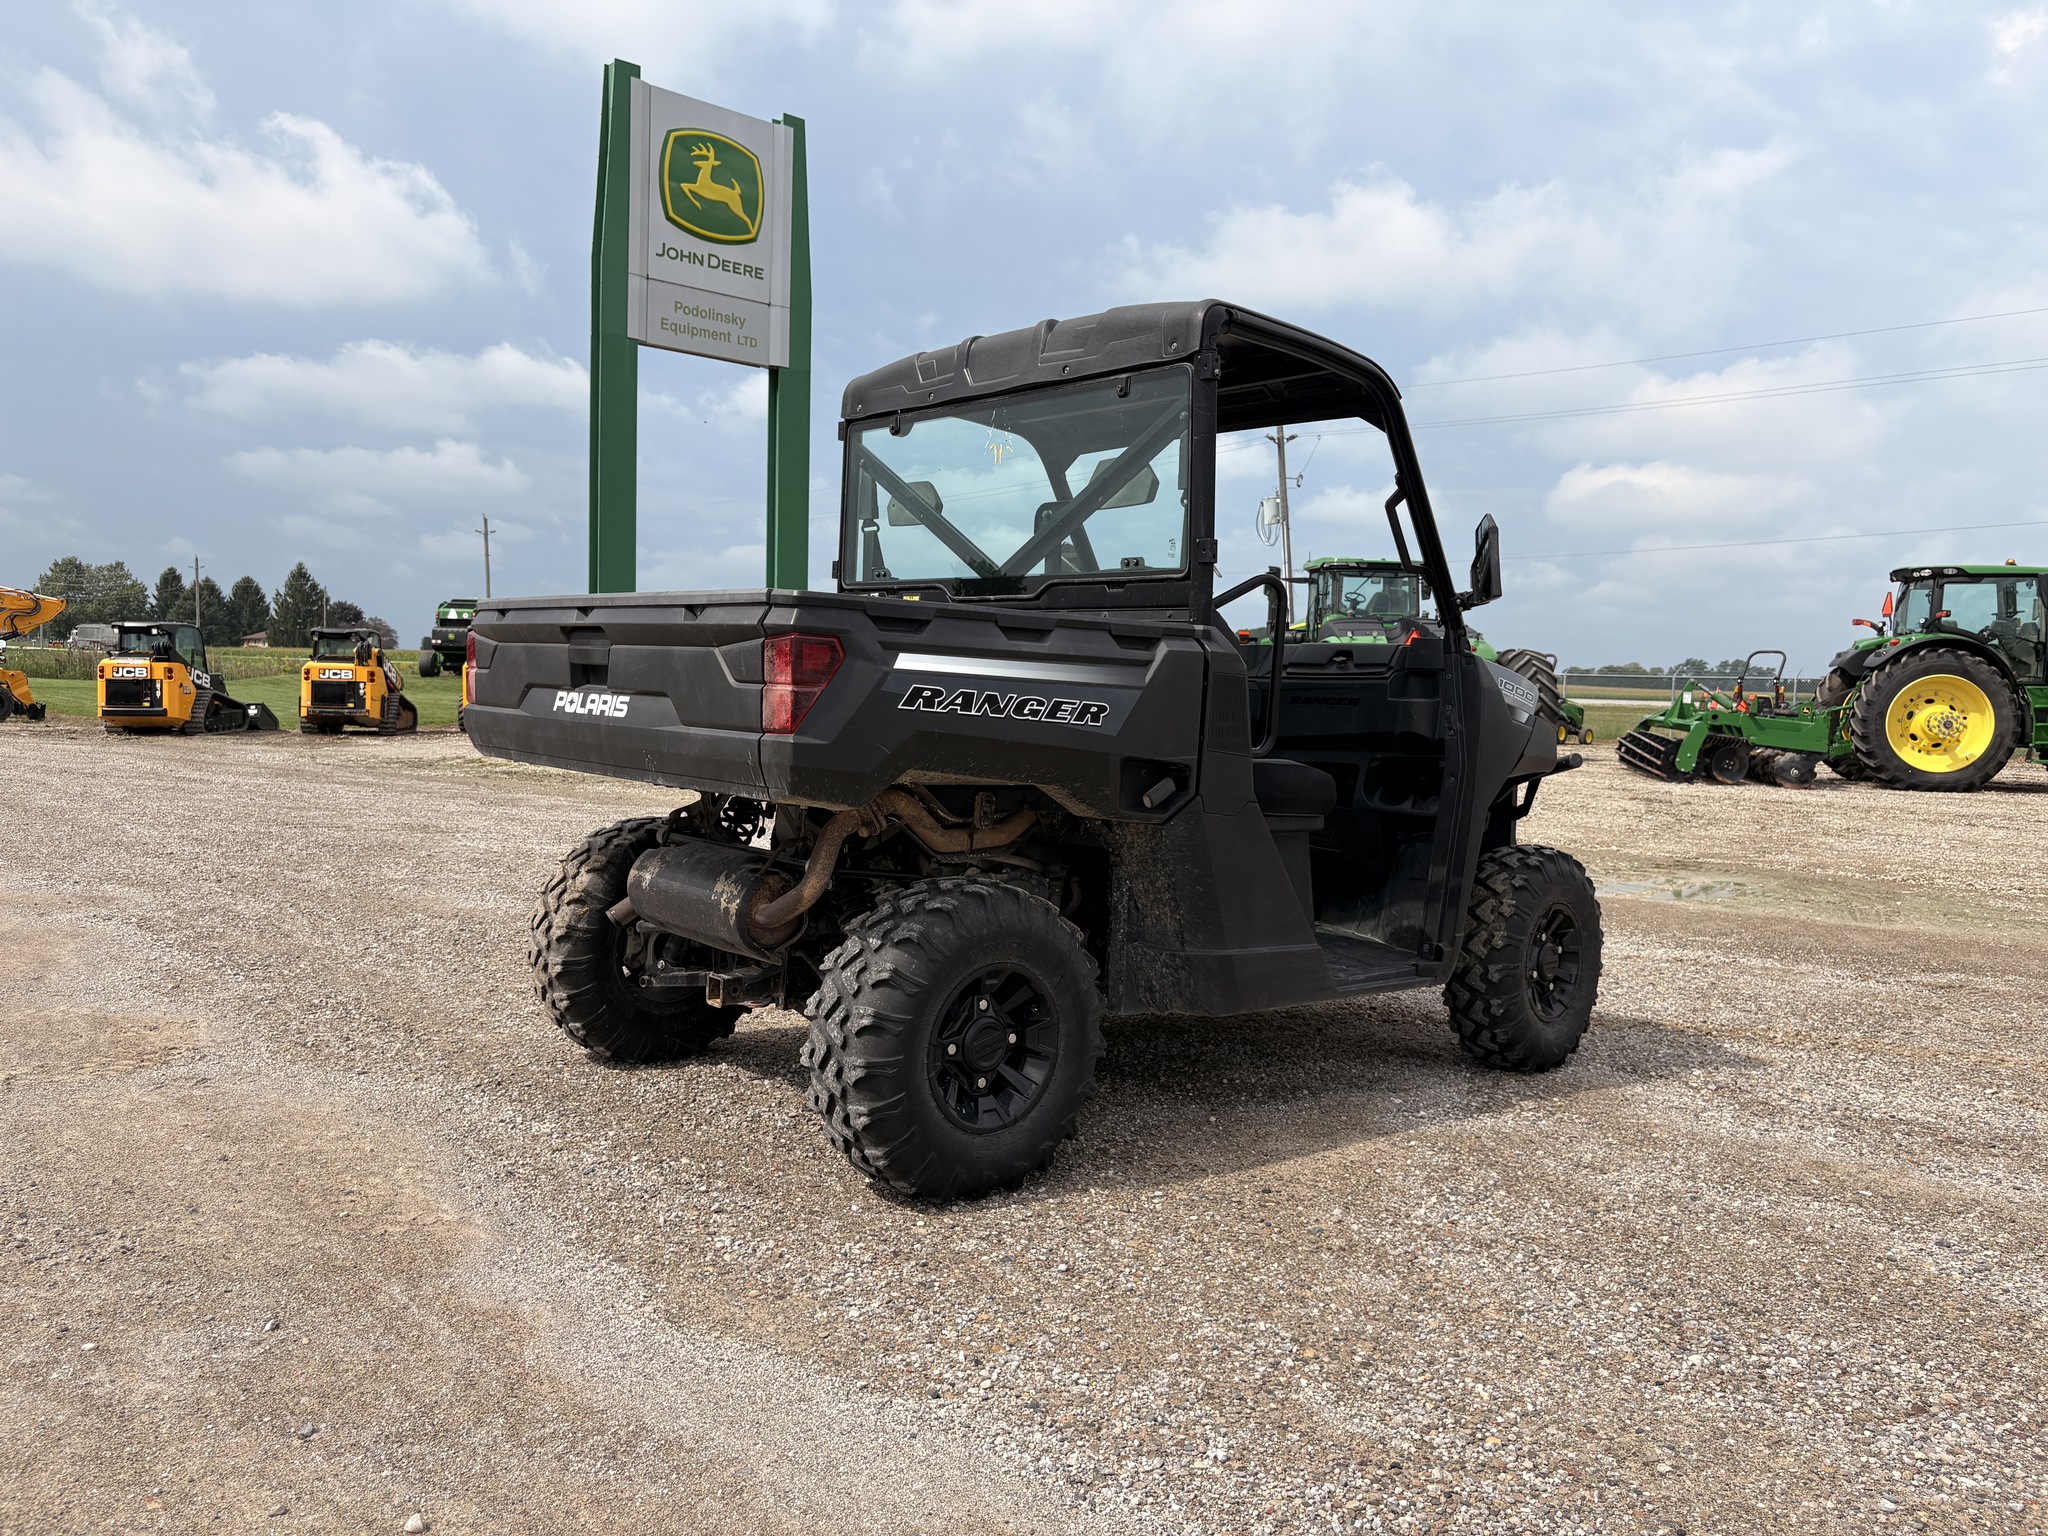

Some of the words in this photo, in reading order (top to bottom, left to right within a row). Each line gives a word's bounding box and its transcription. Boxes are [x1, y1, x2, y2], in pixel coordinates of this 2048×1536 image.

[656, 242, 704, 267] JOHN
[707, 253, 764, 281] DEERE
[674, 300, 746, 330] Podolinsky
[660, 317, 732, 343] Equipment
[737, 334, 758, 349] LTD
[112, 667, 148, 678] JCB
[189, 667, 211, 689] JCB
[319, 669, 353, 679] JCB
[383, 659, 398, 684] JCB
[553, 690, 631, 718] POLARIS
[1288, 695, 1361, 706] RANGER
[1498, 676, 1535, 705] 1000
[898, 684, 1110, 726] RANGER
